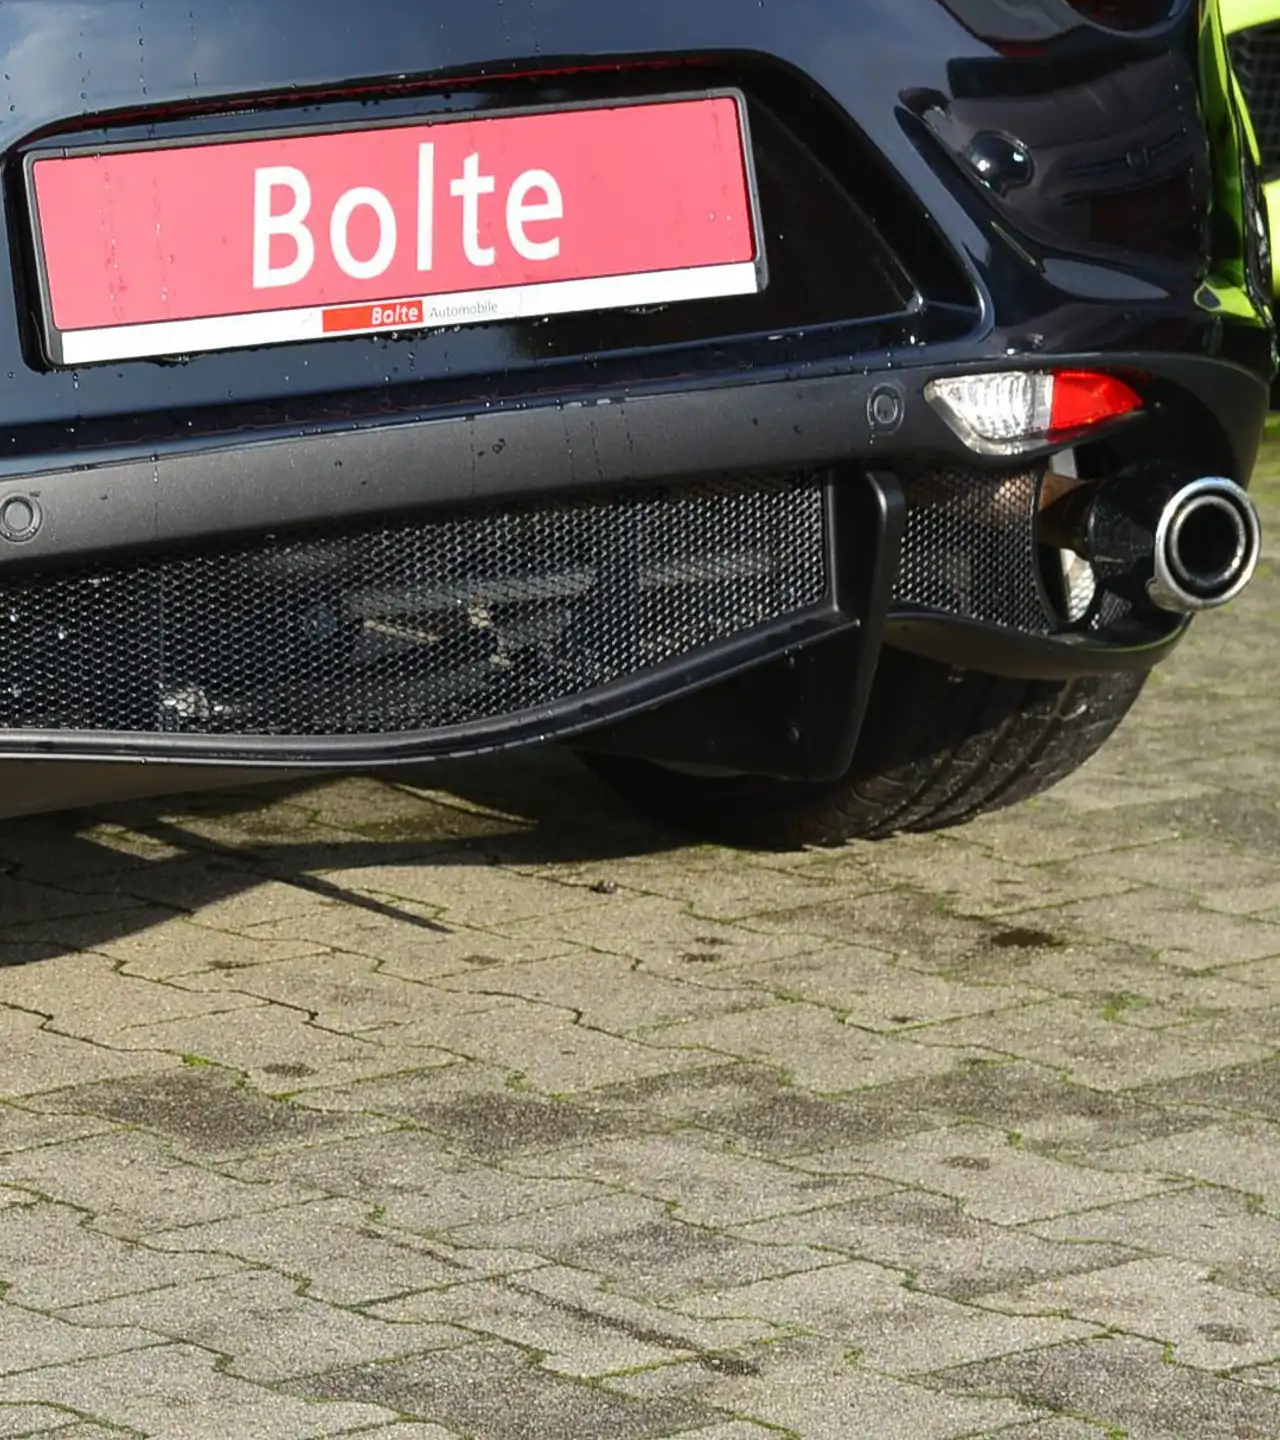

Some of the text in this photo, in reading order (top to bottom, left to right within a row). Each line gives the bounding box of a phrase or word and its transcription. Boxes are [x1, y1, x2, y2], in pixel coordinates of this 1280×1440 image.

[252, 142, 564, 289] Bolte
[372, 300, 498, 325] Bolte Automobile
